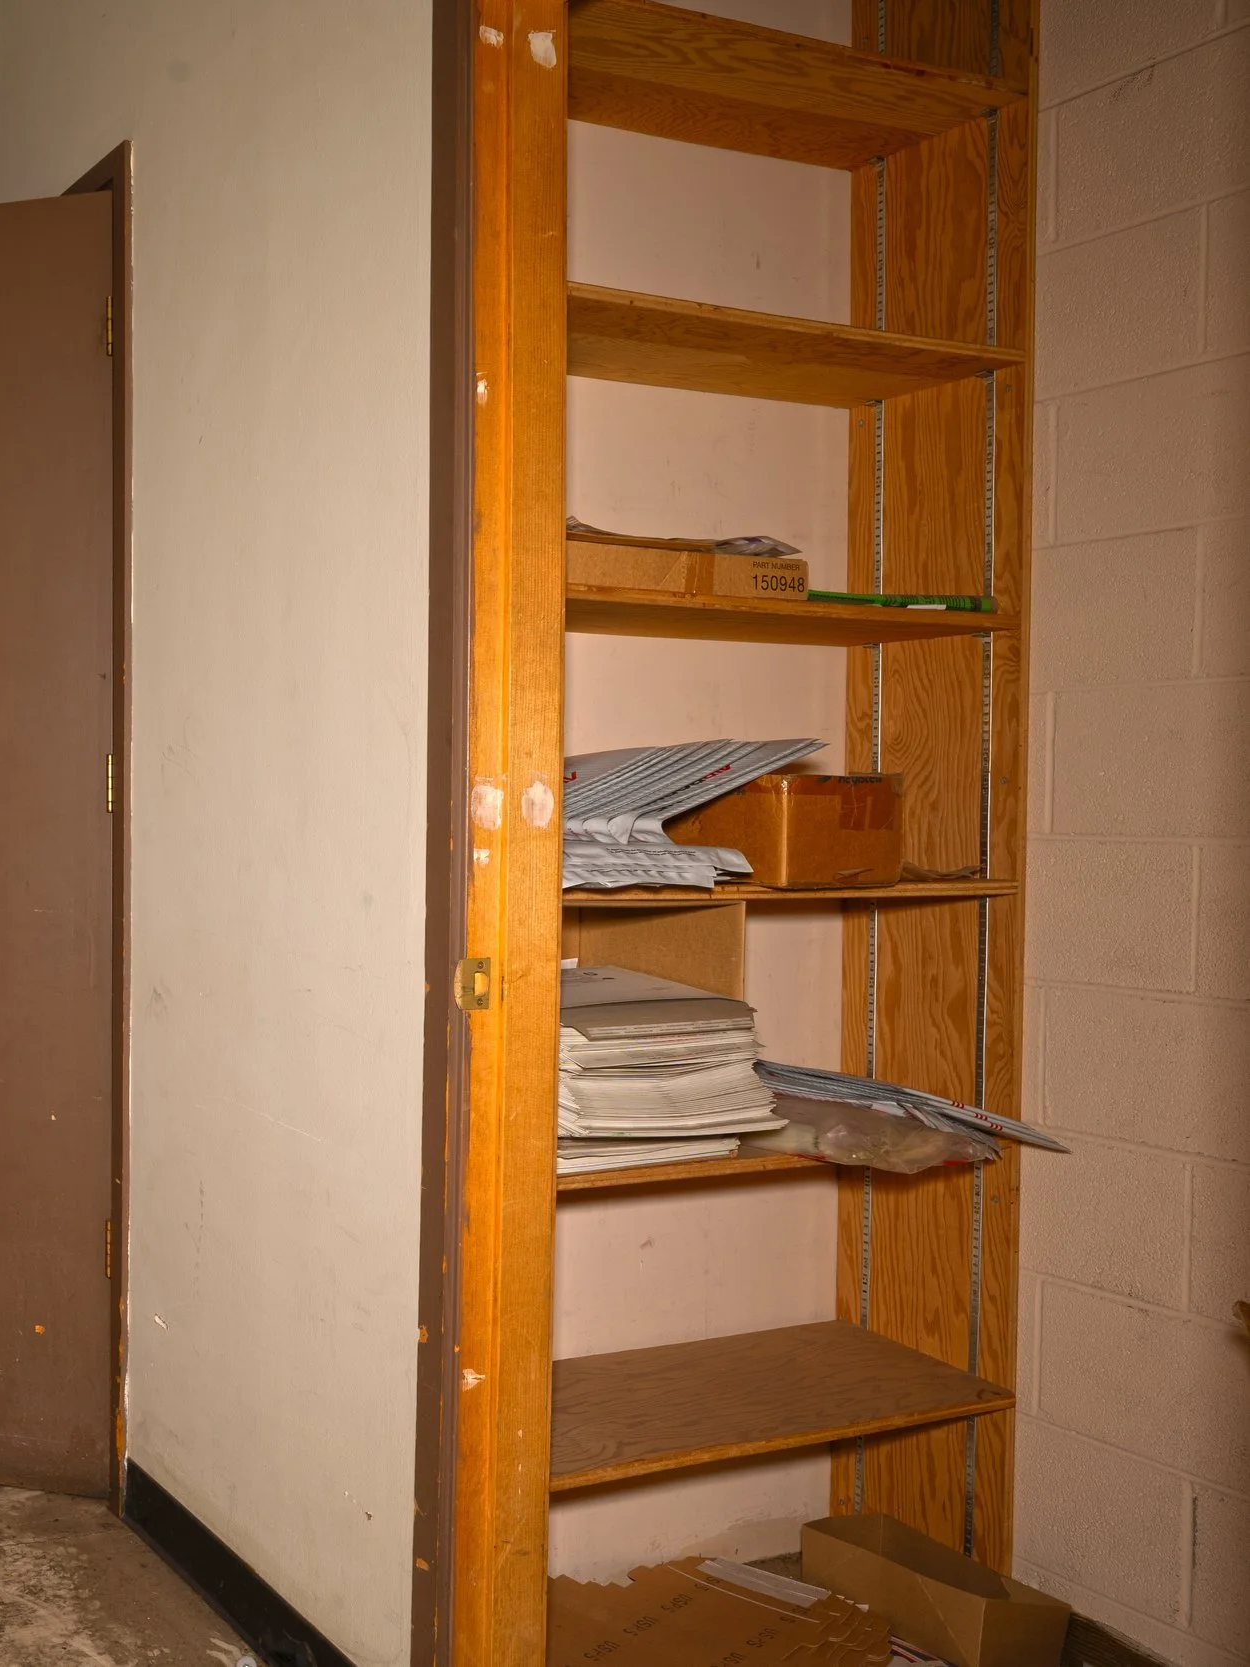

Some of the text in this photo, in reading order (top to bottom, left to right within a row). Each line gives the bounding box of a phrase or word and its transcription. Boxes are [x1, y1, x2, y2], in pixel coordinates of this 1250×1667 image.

[752, 561, 800, 571] PART NUMBER
[752, 573, 805, 593] 150948
[623, 1615, 659, 1637] USPS
[583, 1640, 621, 1662] USPS
